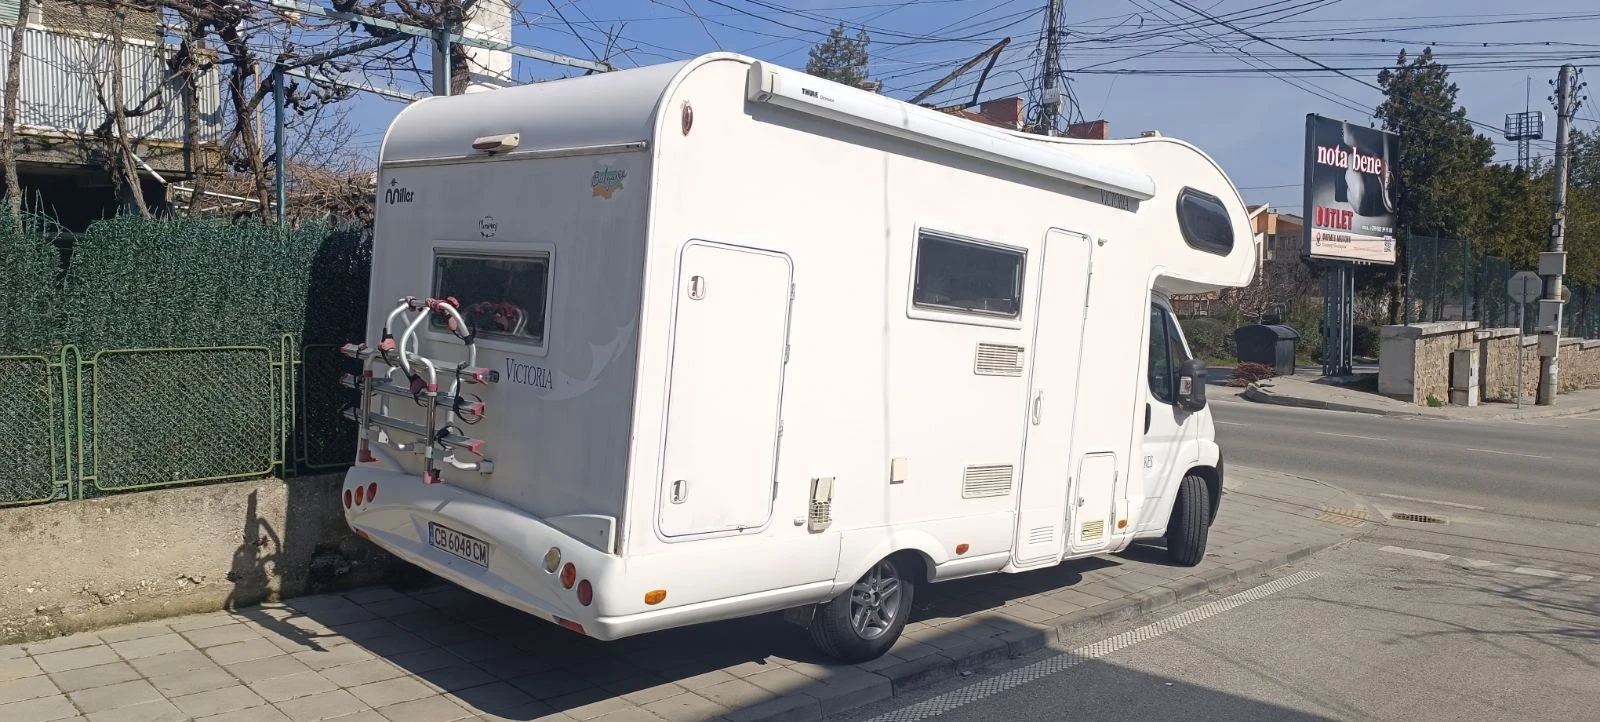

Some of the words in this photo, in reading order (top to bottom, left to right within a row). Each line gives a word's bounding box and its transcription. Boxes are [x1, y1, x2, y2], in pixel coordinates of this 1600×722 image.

[1317, 144, 1348, 168] nota
[1352, 146, 1382, 175] bene
[385, 187, 414, 205] Miller
[1316, 206, 1354, 230] OUTLET
[435, 528, 446, 546] CB
[449, 533, 471, 556] 6048
[474, 543, 486, 563] CM
